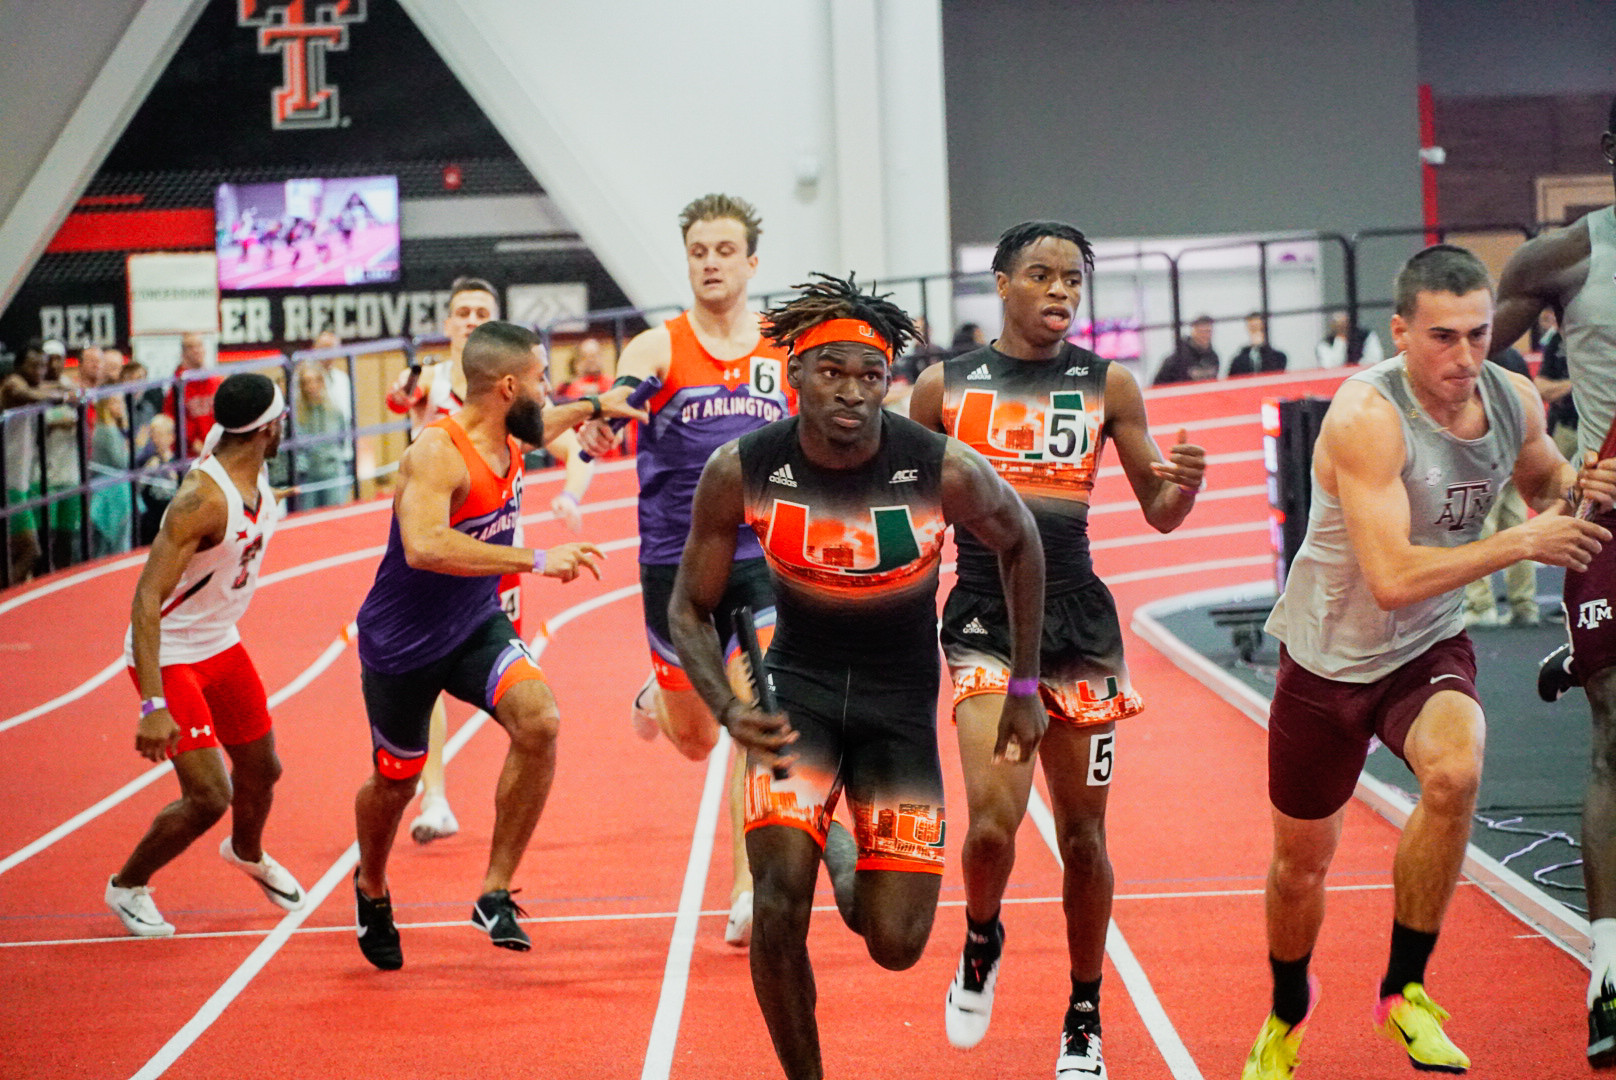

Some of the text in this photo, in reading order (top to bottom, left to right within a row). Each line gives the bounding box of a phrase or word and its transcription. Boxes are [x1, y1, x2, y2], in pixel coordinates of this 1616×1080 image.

[40, 304, 116, 349] RED
[754, 362, 775, 394] 6
[682, 396, 783, 424] UT ARLINGTON
[1049, 413, 1077, 458] 5
[768, 474, 798, 488] adidas
[890, 469, 919, 484] ACC
[764, 498, 923, 577] U
[1075, 675, 1120, 705] U
[1093, 735, 1113, 782] 5
